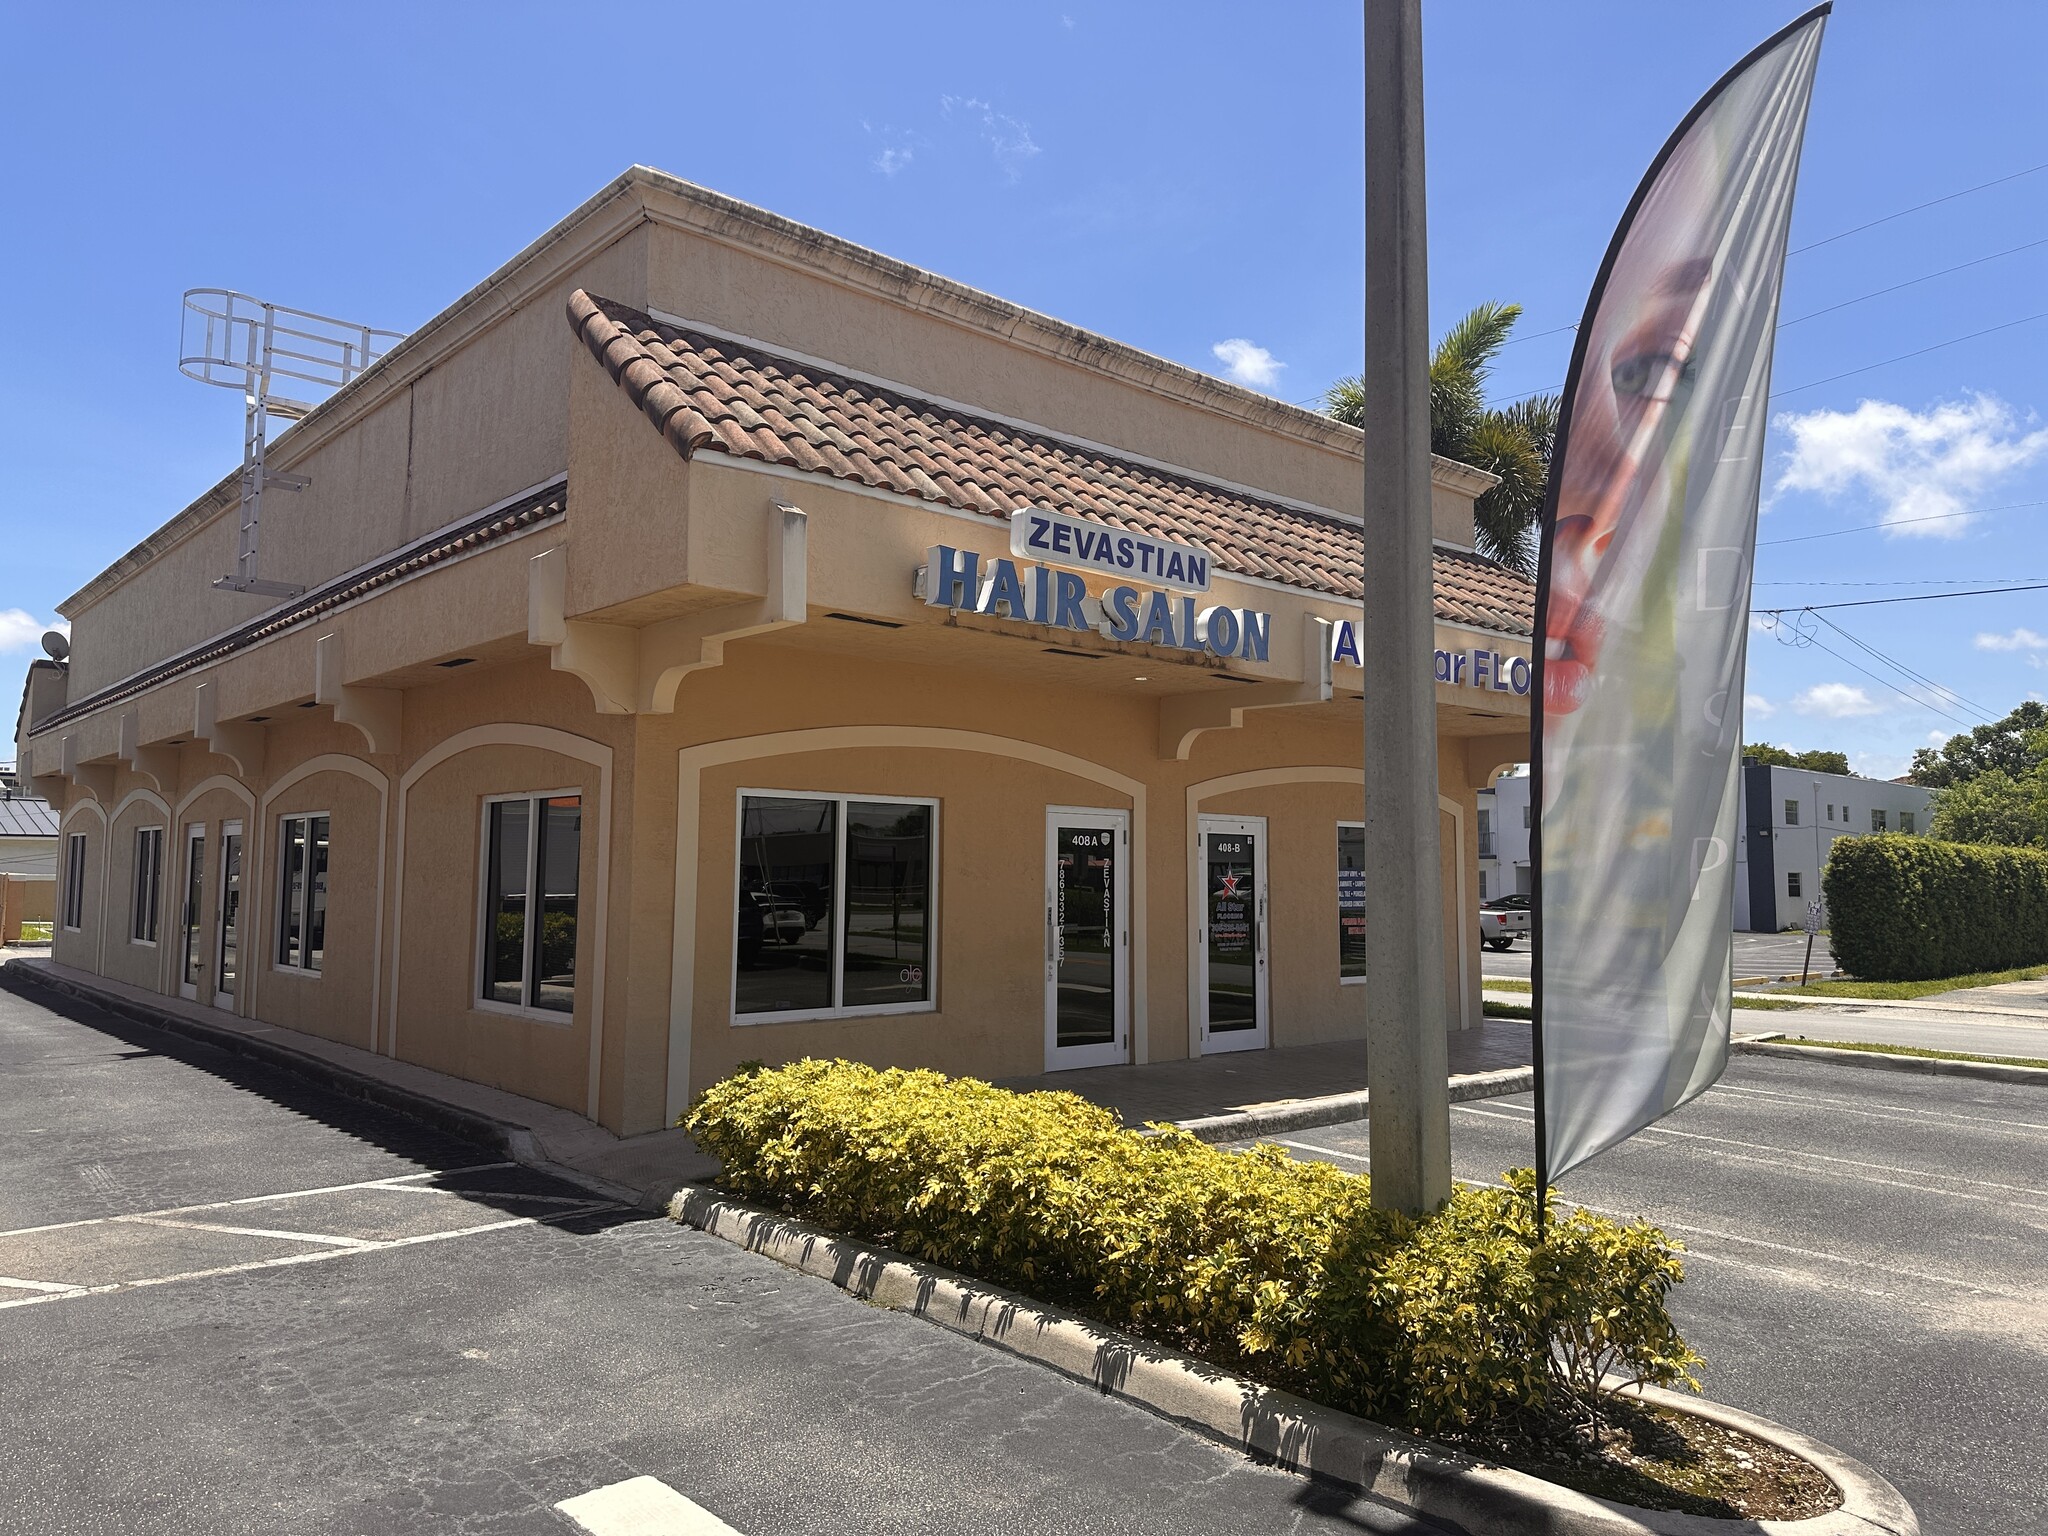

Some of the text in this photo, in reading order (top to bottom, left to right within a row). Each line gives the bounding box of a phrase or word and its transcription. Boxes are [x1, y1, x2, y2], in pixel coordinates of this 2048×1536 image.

[1028, 516, 1206, 586] ZEVASTIAN
[926, 545, 1272, 662] HAIR SALON
[1103, 858, 1111, 948] ZEVASTIAN
